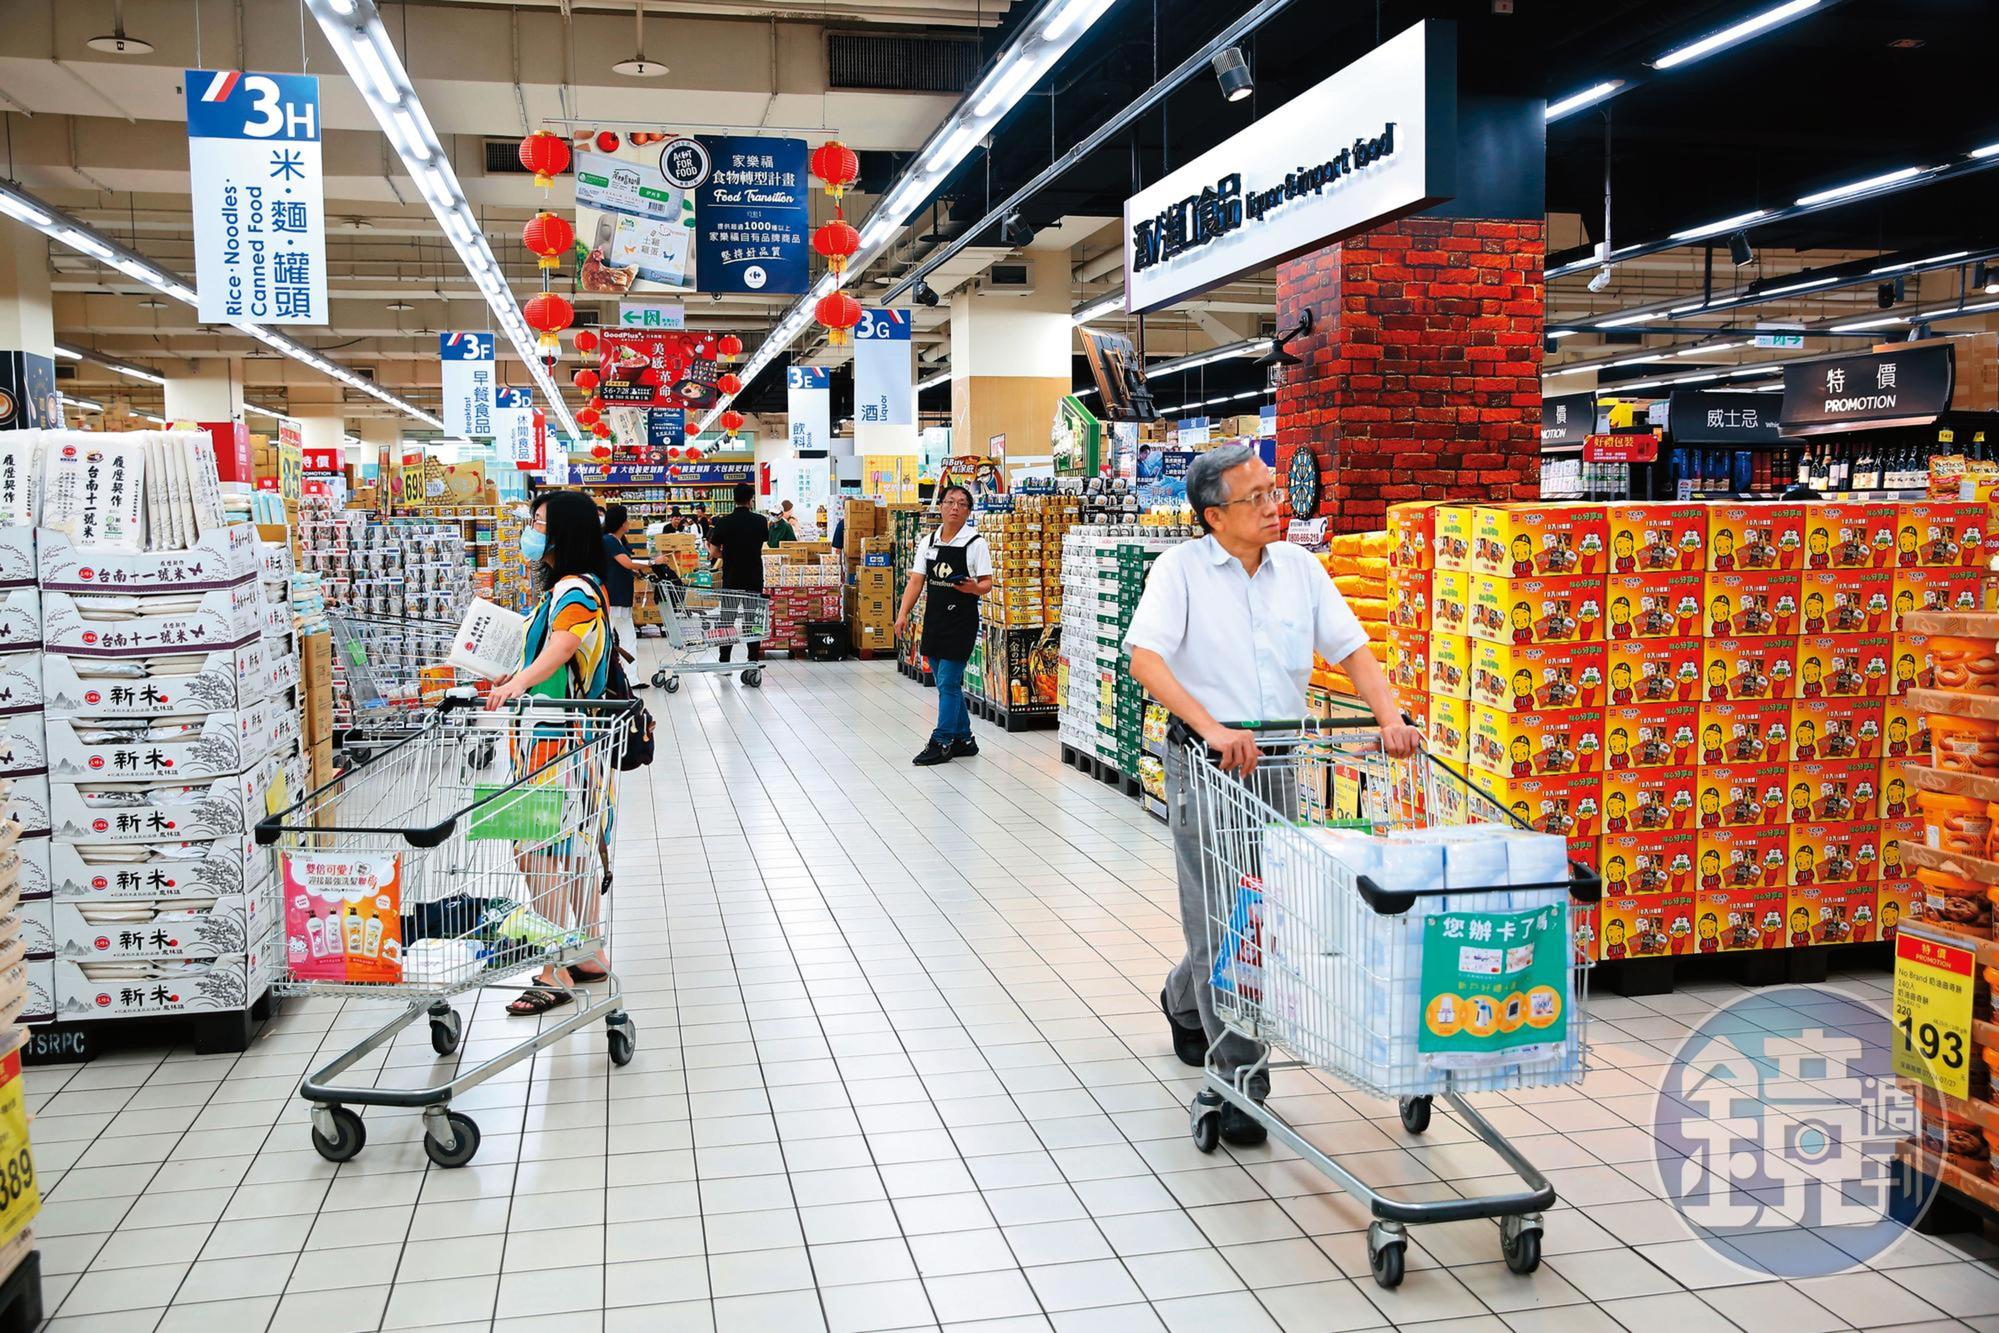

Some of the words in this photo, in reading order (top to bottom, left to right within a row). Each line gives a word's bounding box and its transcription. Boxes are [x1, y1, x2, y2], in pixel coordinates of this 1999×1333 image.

[243, 76, 315, 138] 3H
[676, 159, 693, 169] FOR
[732, 154, 774, 168] 家樂福
[675, 167, 698, 179] FOOD
[712, 171, 795, 187] 食物轉型計畫
[713, 189, 742, 203] Food
[246, 186, 264, 233] Food
[708, 232, 801, 244] 家樂福自有品牌商品
[248, 240, 267, 317] Canned
[856, 310, 890, 339] 3G
[462, 334, 490, 360] 3F
[789, 369, 813, 388] 3E
[1826, 363, 1896, 394] 特價
[473, 370, 491, 434] 早餐食品
[509, 390, 532, 408] 3D
[1824, 395, 1896, 412] PROMOTION
[464, 397, 472, 434] Breakfast
[861, 405, 878, 422] 酒
[1707, 409, 1759, 428] 威士忌
[793, 422, 806, 448] 飲料
[3, 454, 16, 504] 履歷契作
[111, 455, 125, 507] 履歷契作
[405, 473, 424, 501] 698
[83, 465, 99, 538] 台南十一號米
[98, 567, 186, 583] 台南十一號米
[101, 629, 189, 648] 台南十一號米
[1009, 641, 1020, 676] 金のコク
[110, 684, 161, 707] 新米
[114, 748, 167, 771] 新米
[116, 810, 169, 833] 新米
[116, 869, 169, 890] 新米
[119, 928, 172, 950] 新米
[1915, 953, 1952, 969] PROMOTION
[1898, 968, 1908, 977] No
[1909, 971, 1928, 983] Brand
[120, 984, 174, 1006] 新米
[1896, 1004, 1912, 1017] 220
[1898, 1016, 1963, 1069] 193
